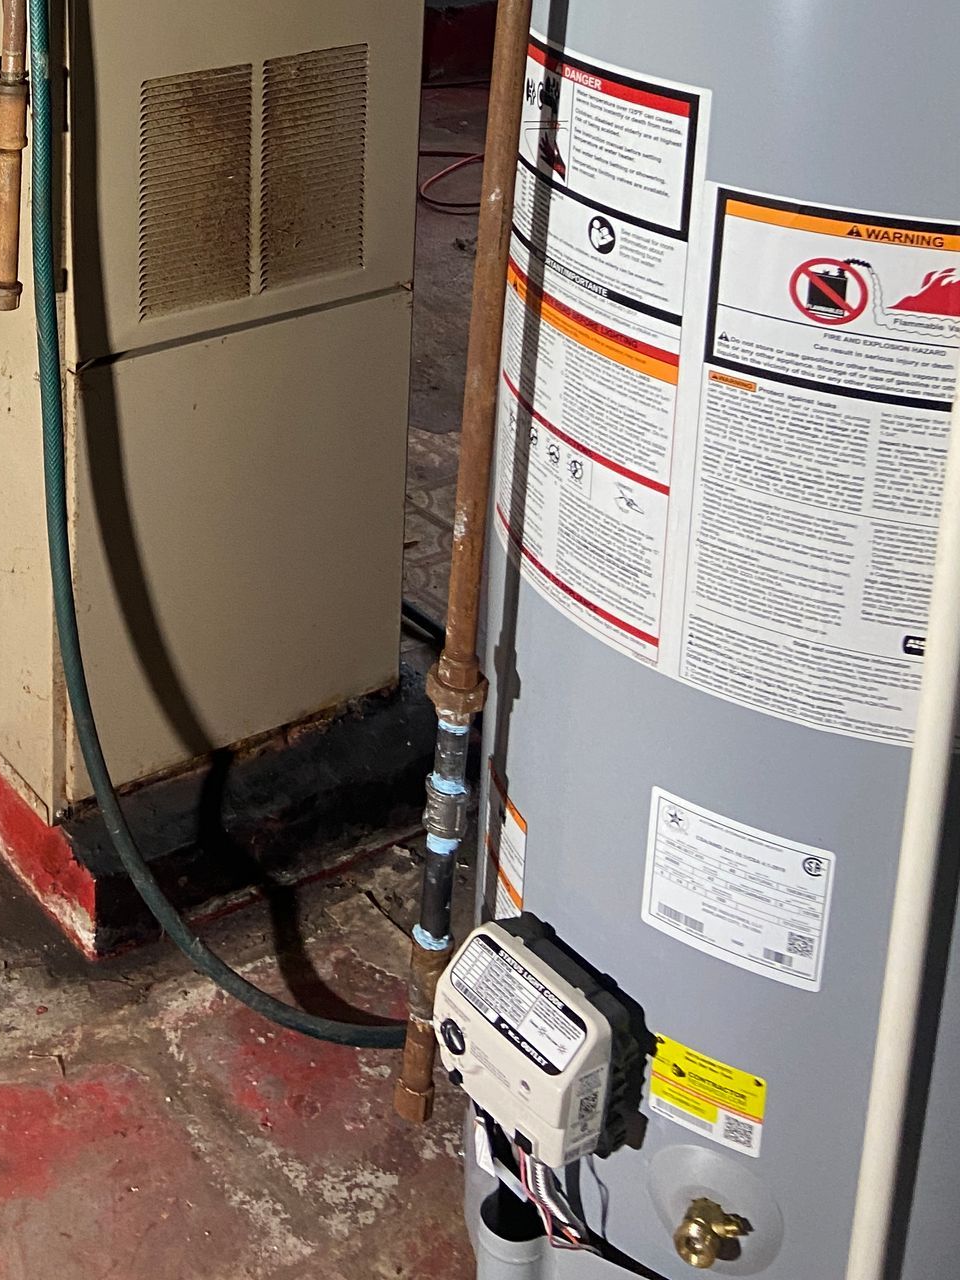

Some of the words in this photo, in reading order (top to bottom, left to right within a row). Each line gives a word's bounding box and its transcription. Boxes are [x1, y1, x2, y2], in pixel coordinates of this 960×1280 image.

[564, 65, 603, 91] DANGER
[865, 228, 945, 248] WARNING
[893, 318, 944, 331] Flammable
[824, 333, 841, 341] FIRE
[843, 336, 861, 344] AND
[862, 340, 910, 352] EXPLOSION
[912, 347, 946, 357] HAZARD
[830, 347, 854, 356] result
[864, 353, 894, 362] serious
[896, 358, 919, 367] injury
[755, 344, 774, 352] store
[801, 355, 834, 365] gasoline
[846, 363, 867, 371] other
[868, 366, 910, 378] flammable
[912, 373, 939, 382] vapors
[718, 376, 753, 389] WARNING
[758, 386, 784, 398] Protect
[787, 395, 814, 404] against
[817, 400, 837, 409] leaks
[499, 950, 524, 974] STATUS
[522, 971, 544, 991] LIGHT
[543, 990, 564, 1009] CODE
[521, 1041, 548, 1066] OUTLET
